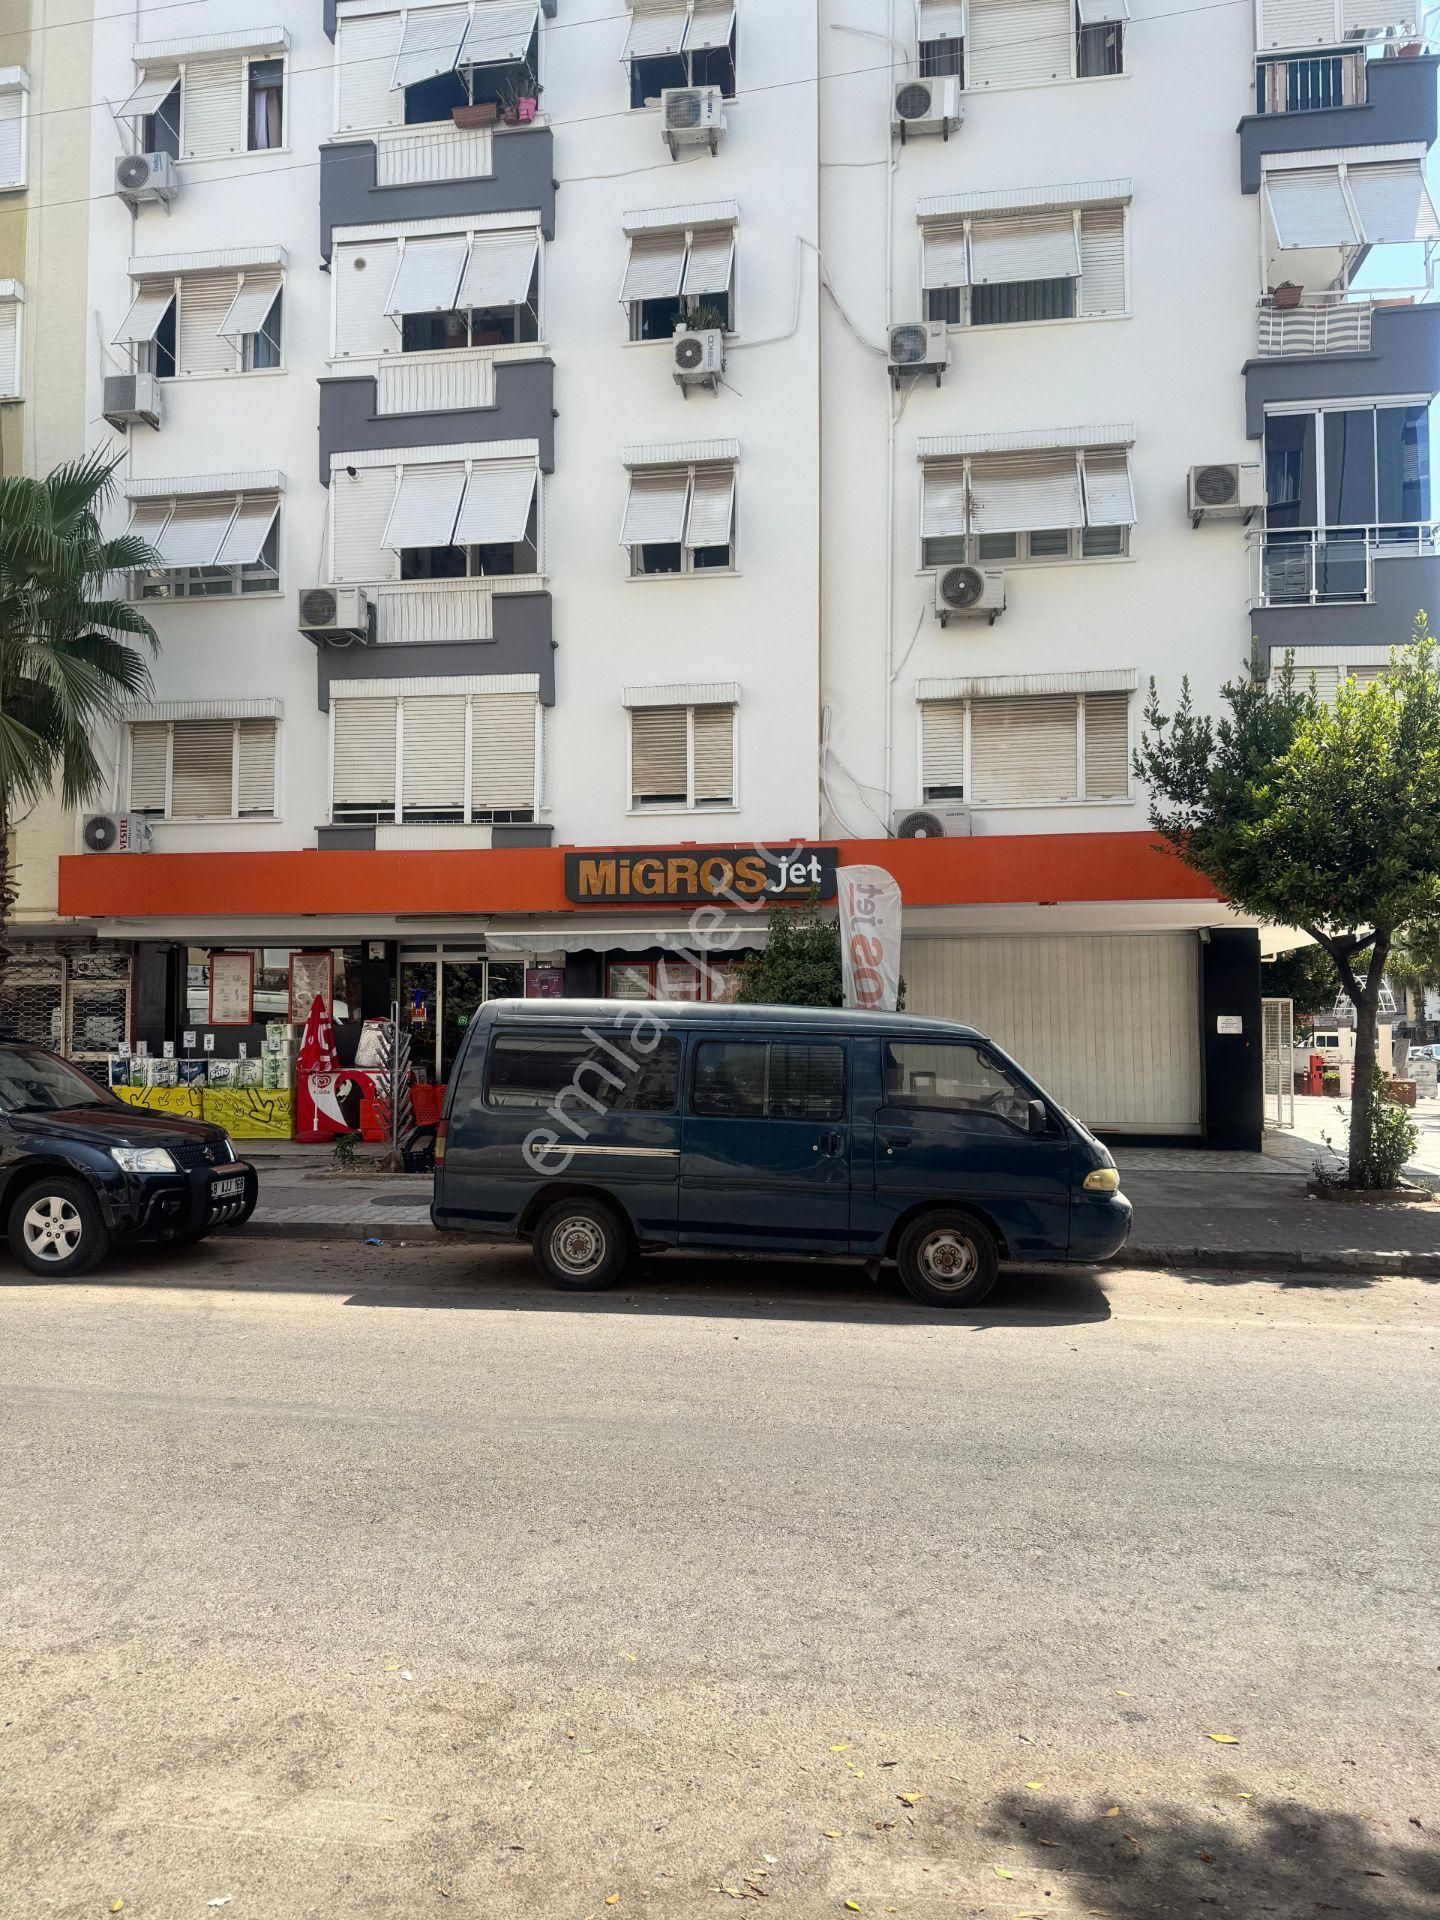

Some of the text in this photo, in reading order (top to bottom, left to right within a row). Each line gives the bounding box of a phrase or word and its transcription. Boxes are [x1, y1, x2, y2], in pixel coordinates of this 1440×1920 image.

[119, 817, 128, 851] VESTEL
[578, 855, 767, 896] MiGROS
[770, 855, 822, 893] jet
[210, 1066, 230, 1080] Solo
